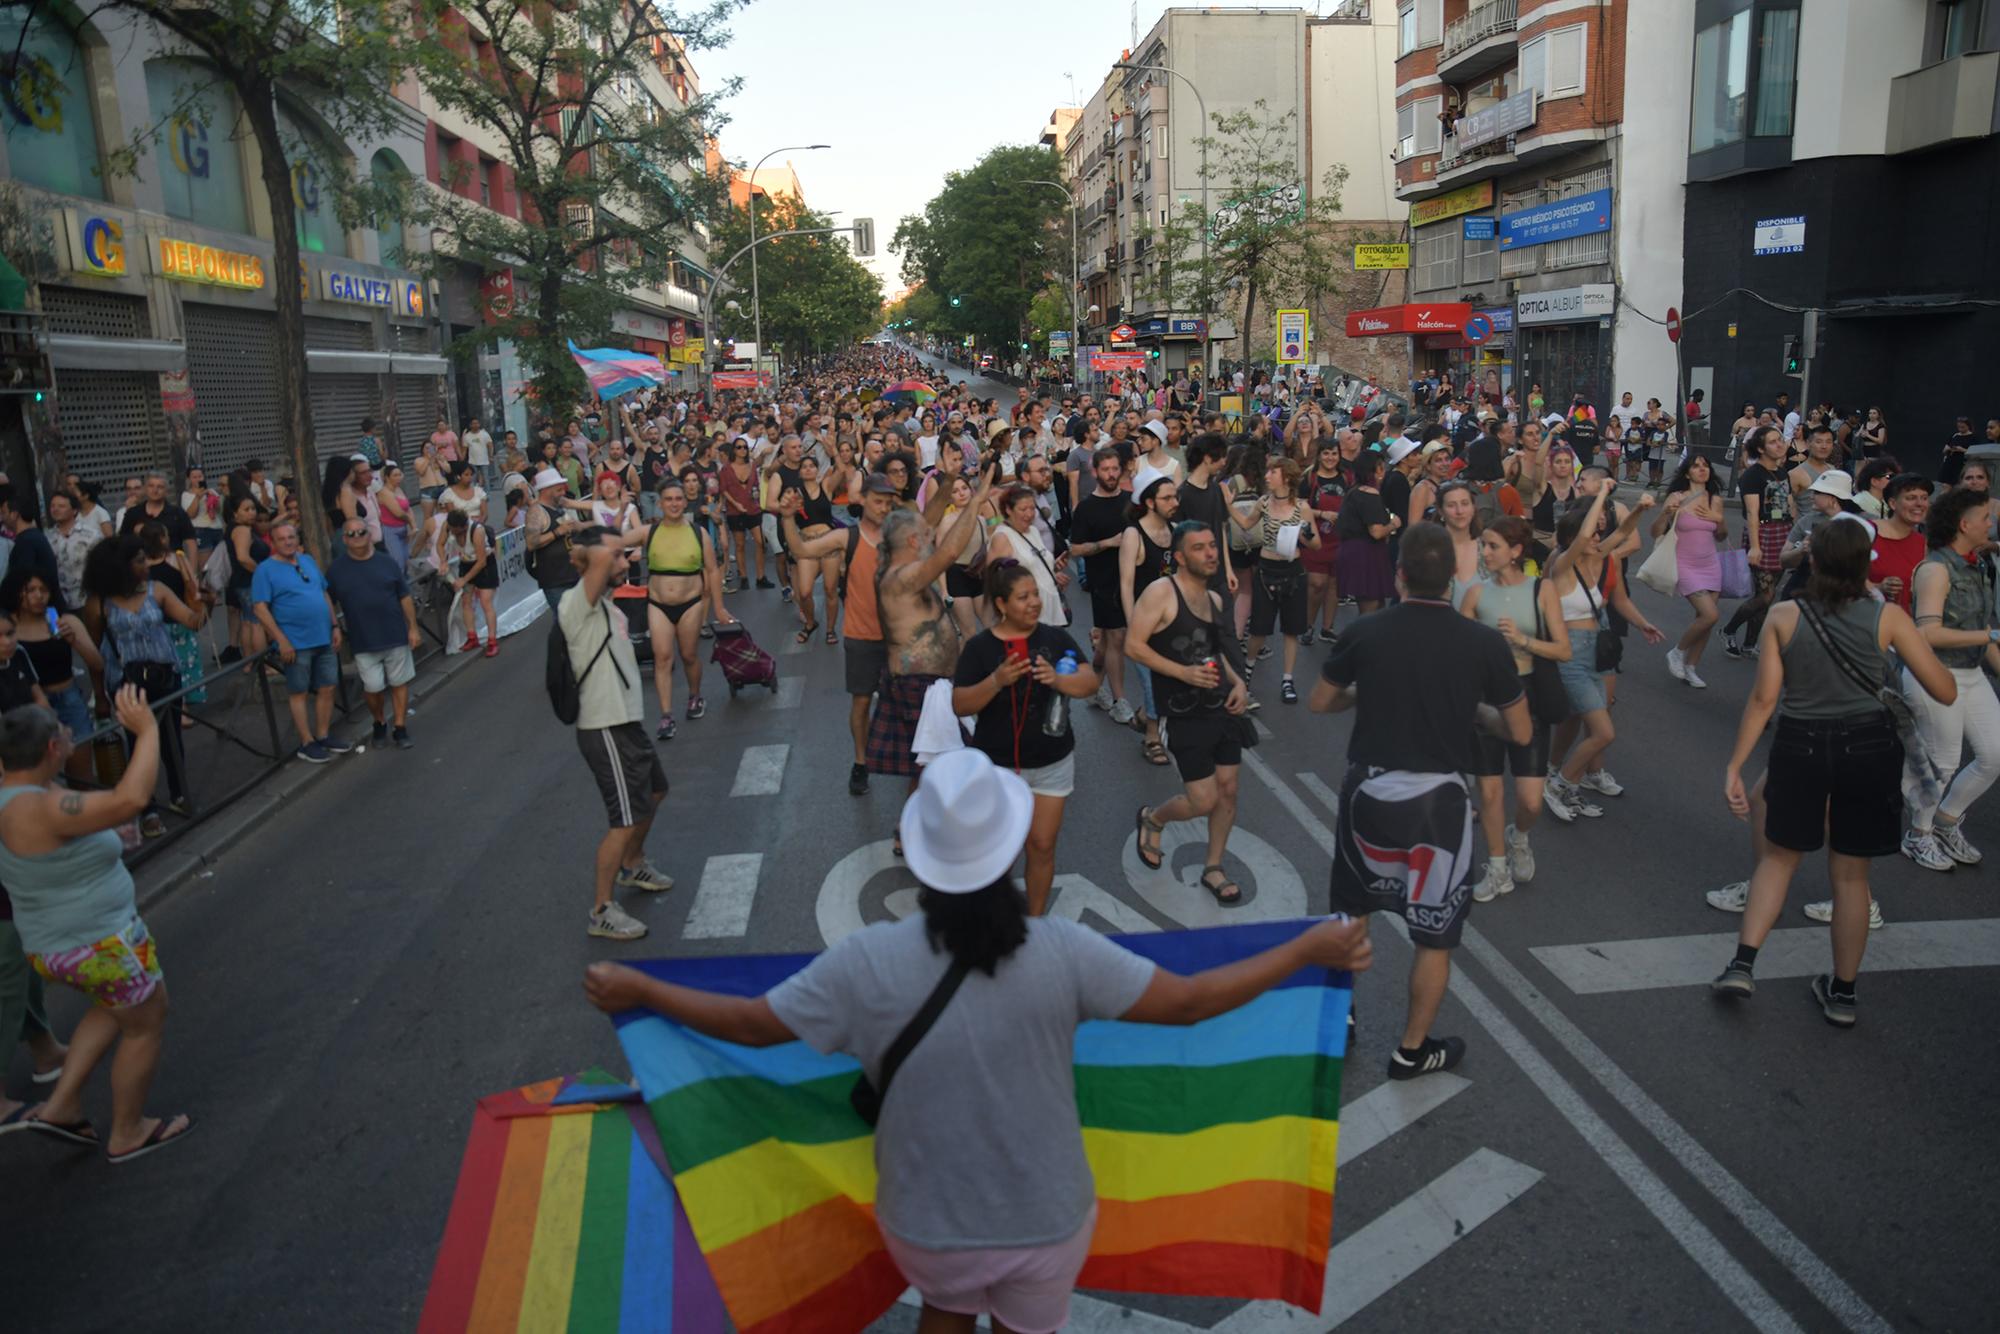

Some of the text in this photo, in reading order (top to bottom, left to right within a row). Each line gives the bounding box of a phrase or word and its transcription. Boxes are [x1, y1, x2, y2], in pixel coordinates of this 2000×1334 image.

[1511, 200, 1595, 230] CENTRO MÉDICO PSICOTÉCNICO
[1757, 216, 1804, 227] DISPONIBLE
[1360, 246, 1404, 254] FOTOGRAFIA
[159, 239, 265, 288] DEPORTES
[330, 272, 393, 305] GALVEZ
[1519, 296, 1582, 315] OPTICA ALBUF
[1417, 320, 1444, 329] Halcón
